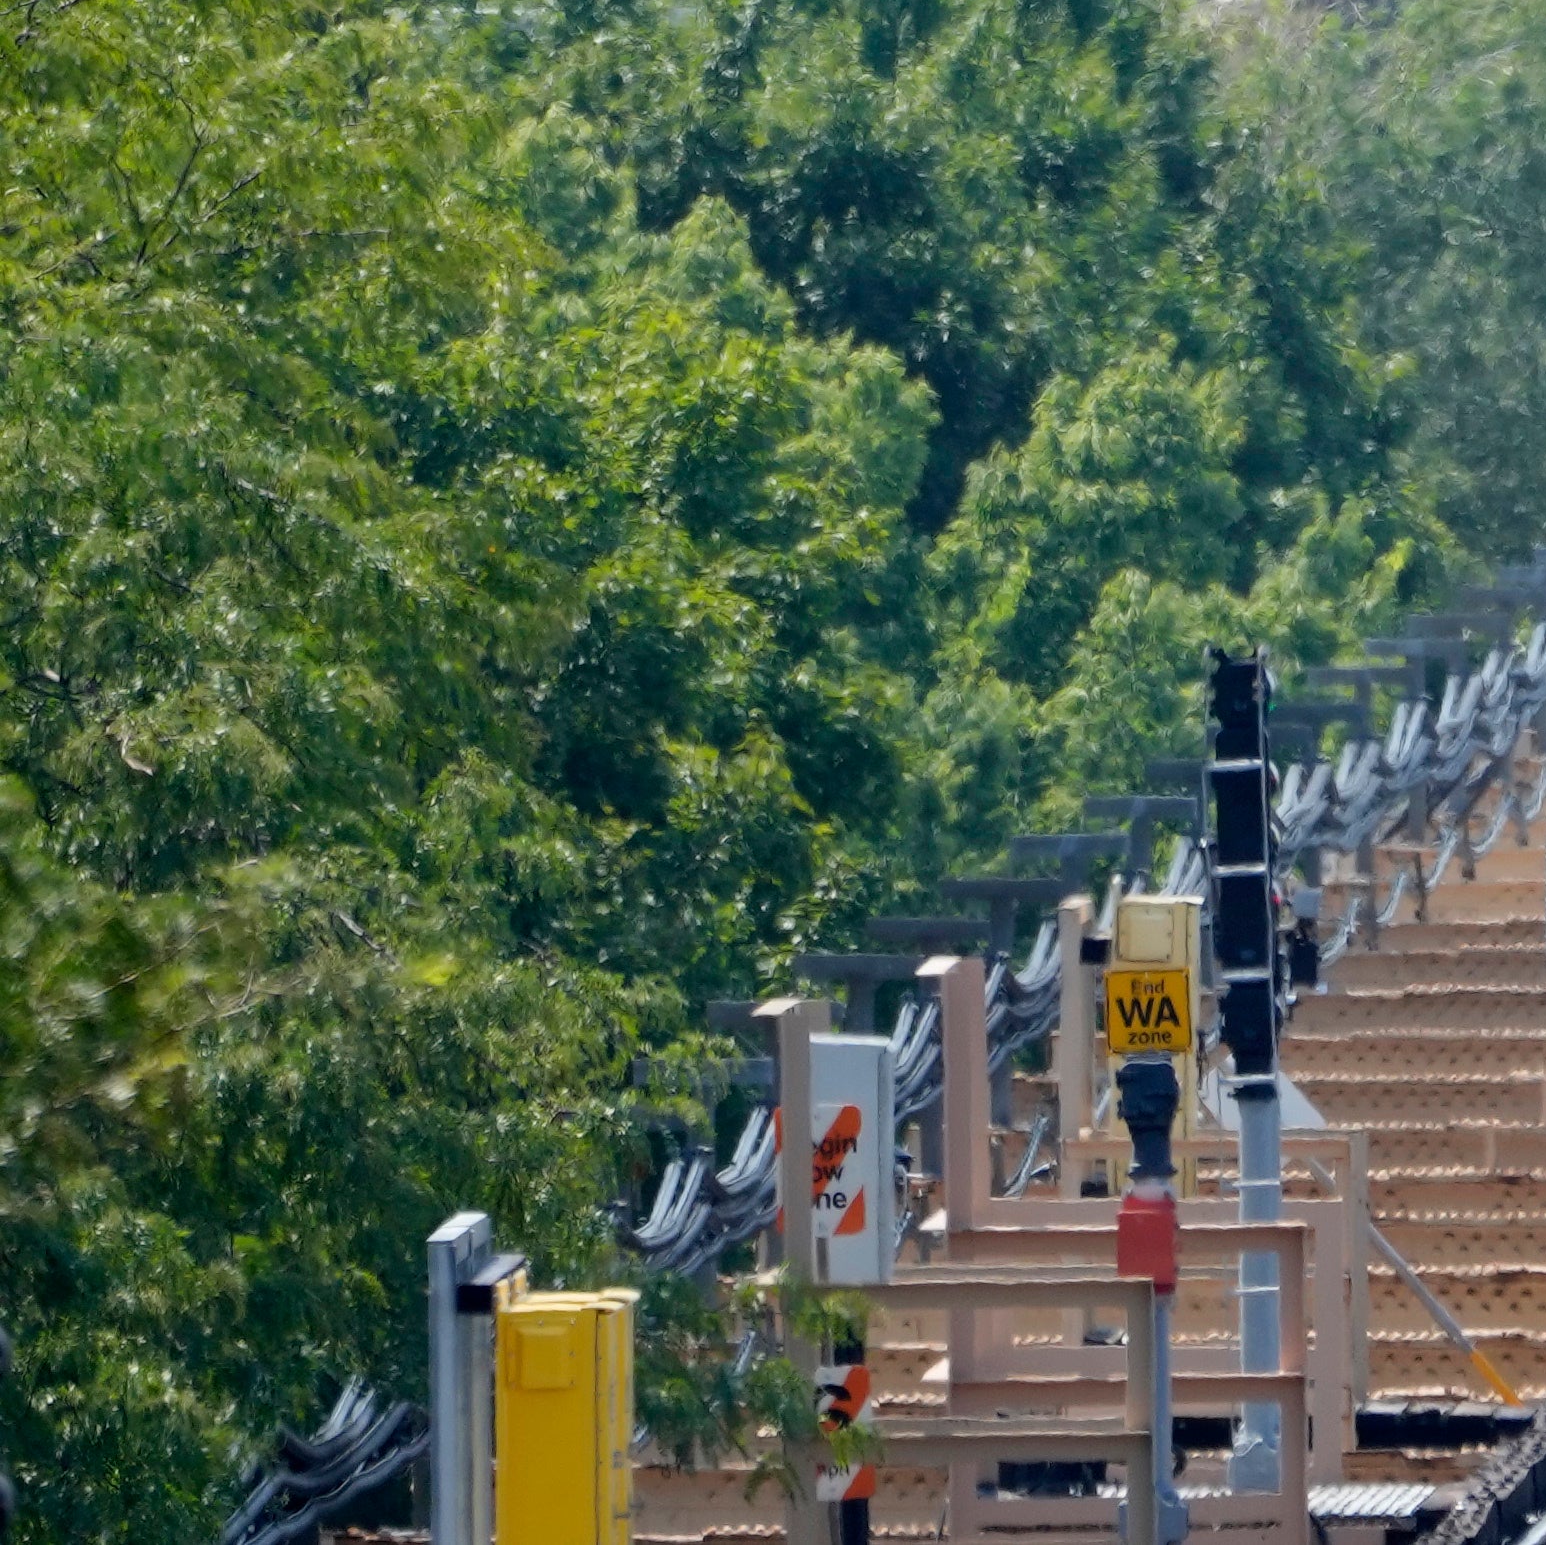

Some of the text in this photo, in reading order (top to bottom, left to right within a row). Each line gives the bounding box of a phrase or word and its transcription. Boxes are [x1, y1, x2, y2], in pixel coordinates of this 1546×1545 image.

[1130, 979, 1165, 994] End
[1116, 995, 1180, 1028] WA
[1128, 1031, 1172, 1045] zone
